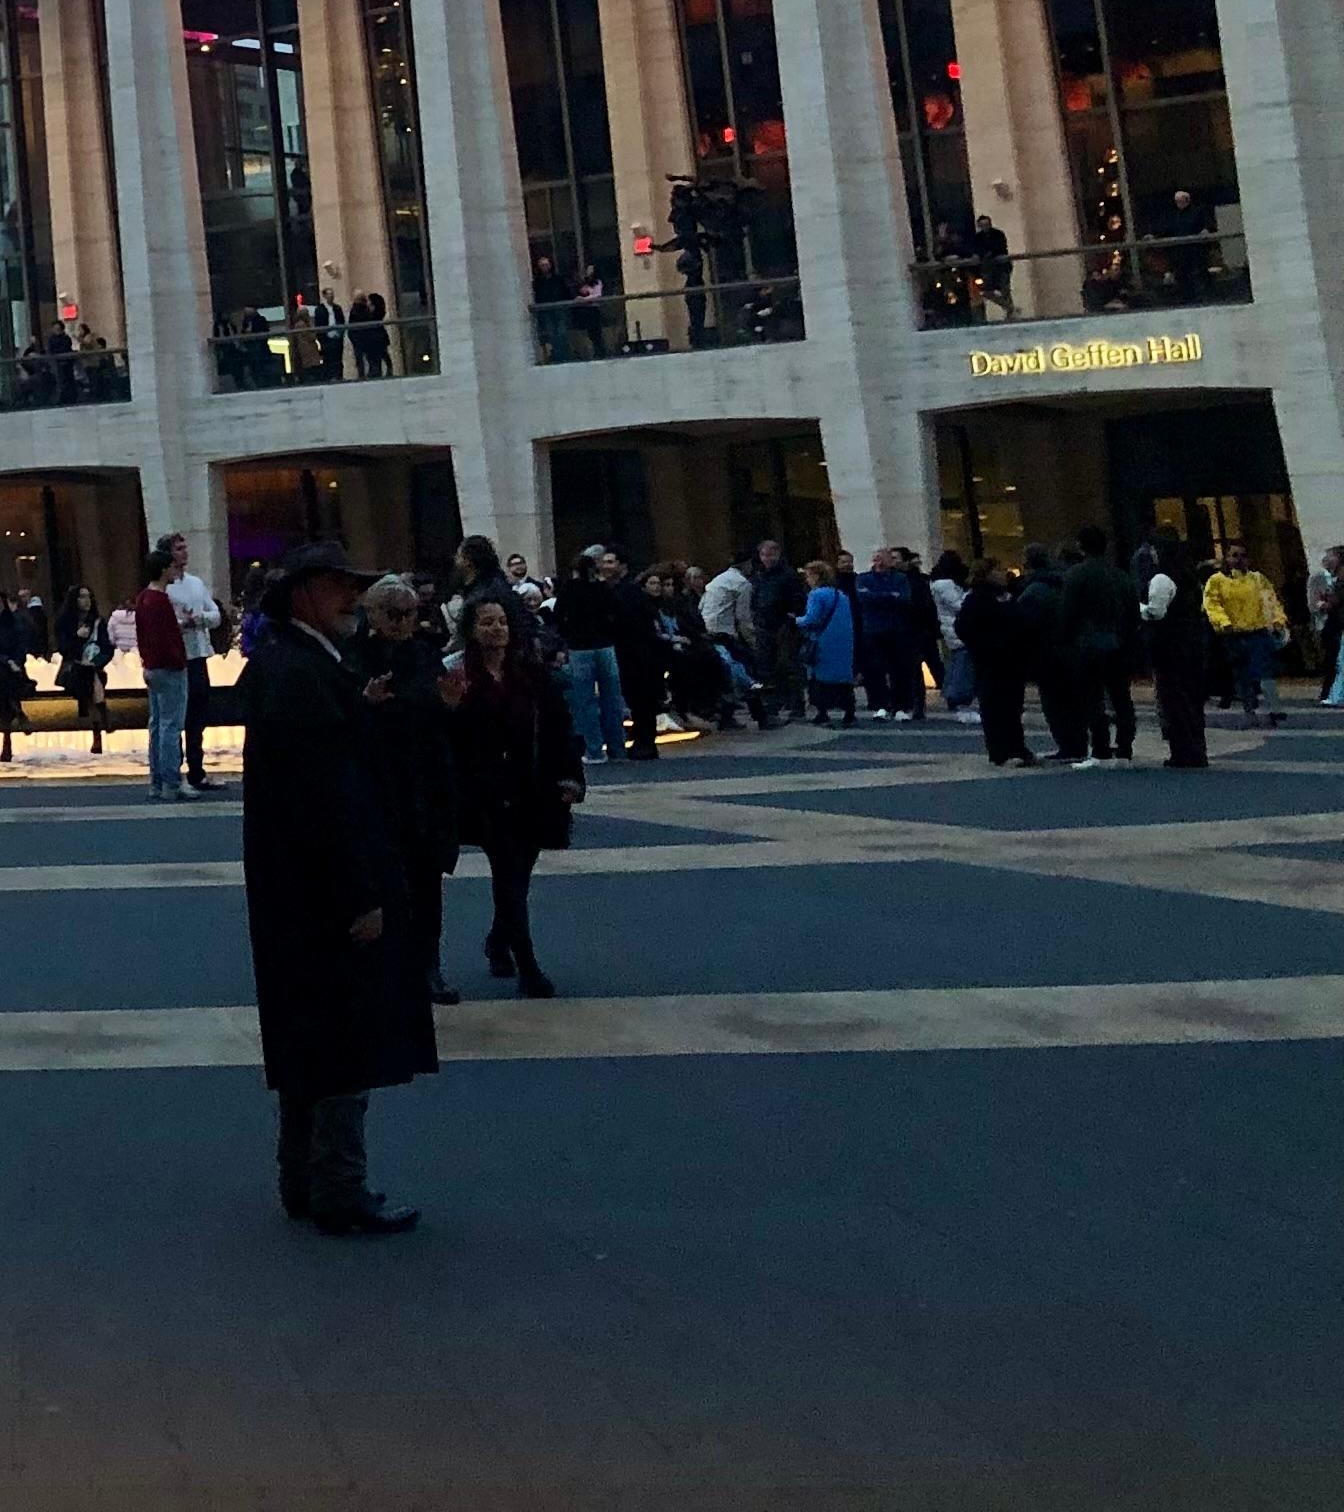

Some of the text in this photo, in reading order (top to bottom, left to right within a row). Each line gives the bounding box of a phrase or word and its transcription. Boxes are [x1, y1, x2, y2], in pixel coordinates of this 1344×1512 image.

[969, 333, 1202, 377] David Geffen Hall
